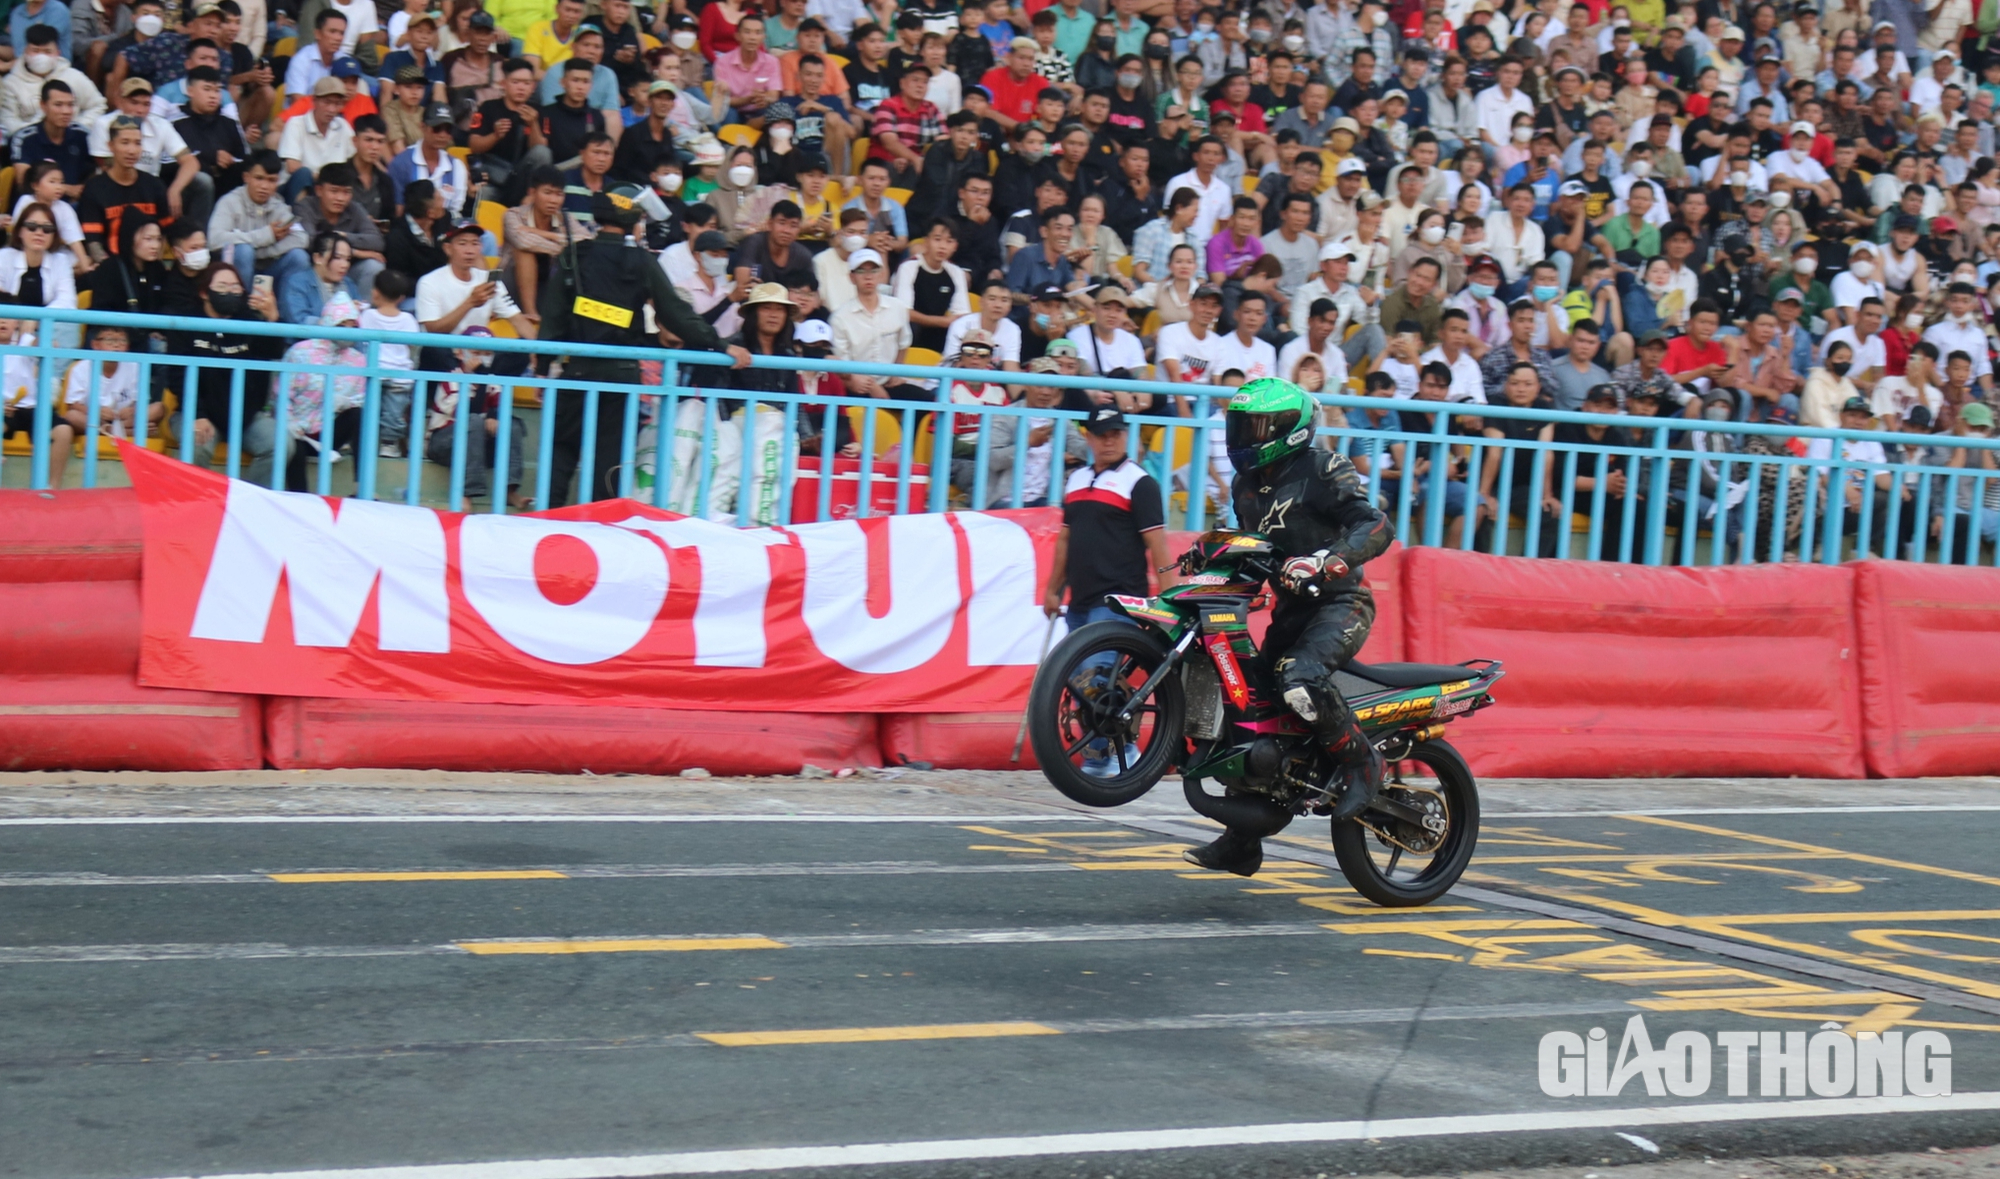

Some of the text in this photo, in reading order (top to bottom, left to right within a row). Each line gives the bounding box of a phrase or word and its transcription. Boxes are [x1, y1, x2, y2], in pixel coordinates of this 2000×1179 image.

[189, 478, 1069, 673] MOTUL
[1208, 613, 1237, 623] YAMAHA
[1373, 696, 1437, 719] SPARK
